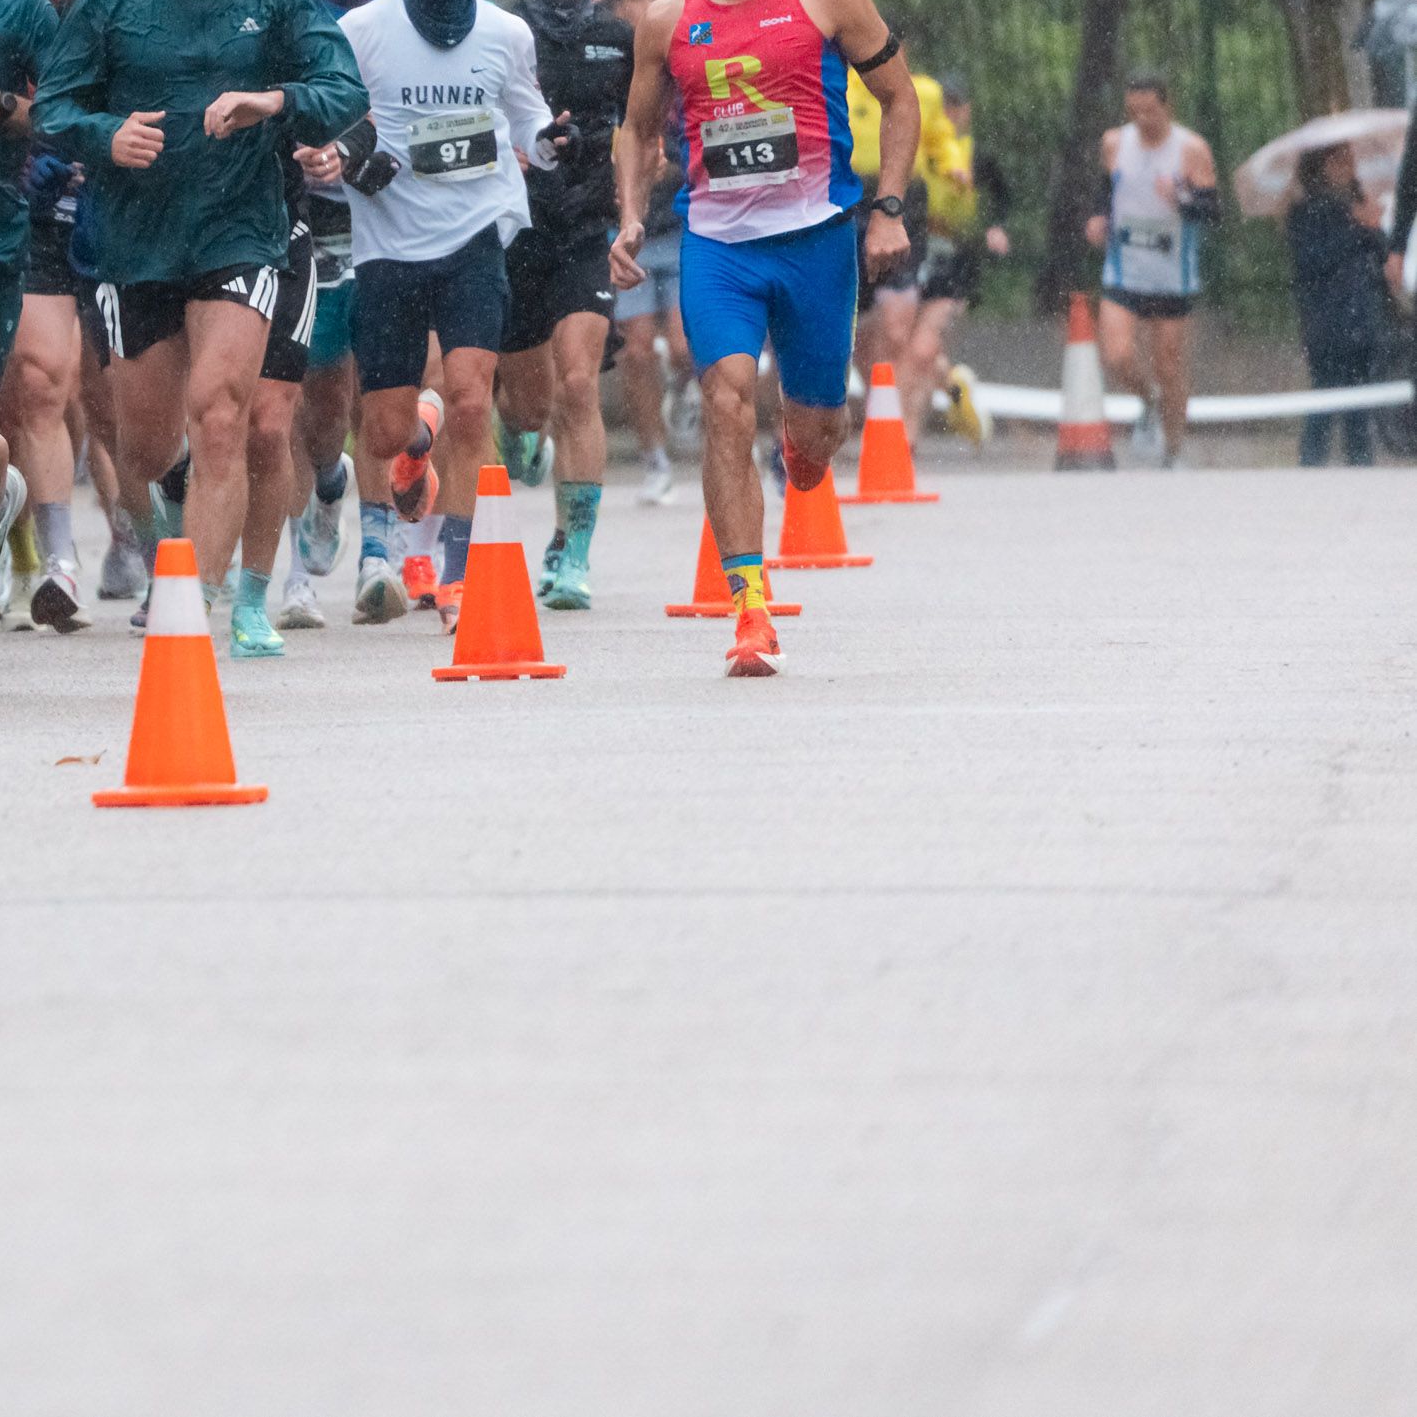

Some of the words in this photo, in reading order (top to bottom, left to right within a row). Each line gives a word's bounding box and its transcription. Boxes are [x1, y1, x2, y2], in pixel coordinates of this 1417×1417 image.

[401, 85, 485, 105] RUNNER
[713, 102, 745, 119] CLUB
[439, 139, 471, 163] 97
[725, 142, 775, 166] 113
